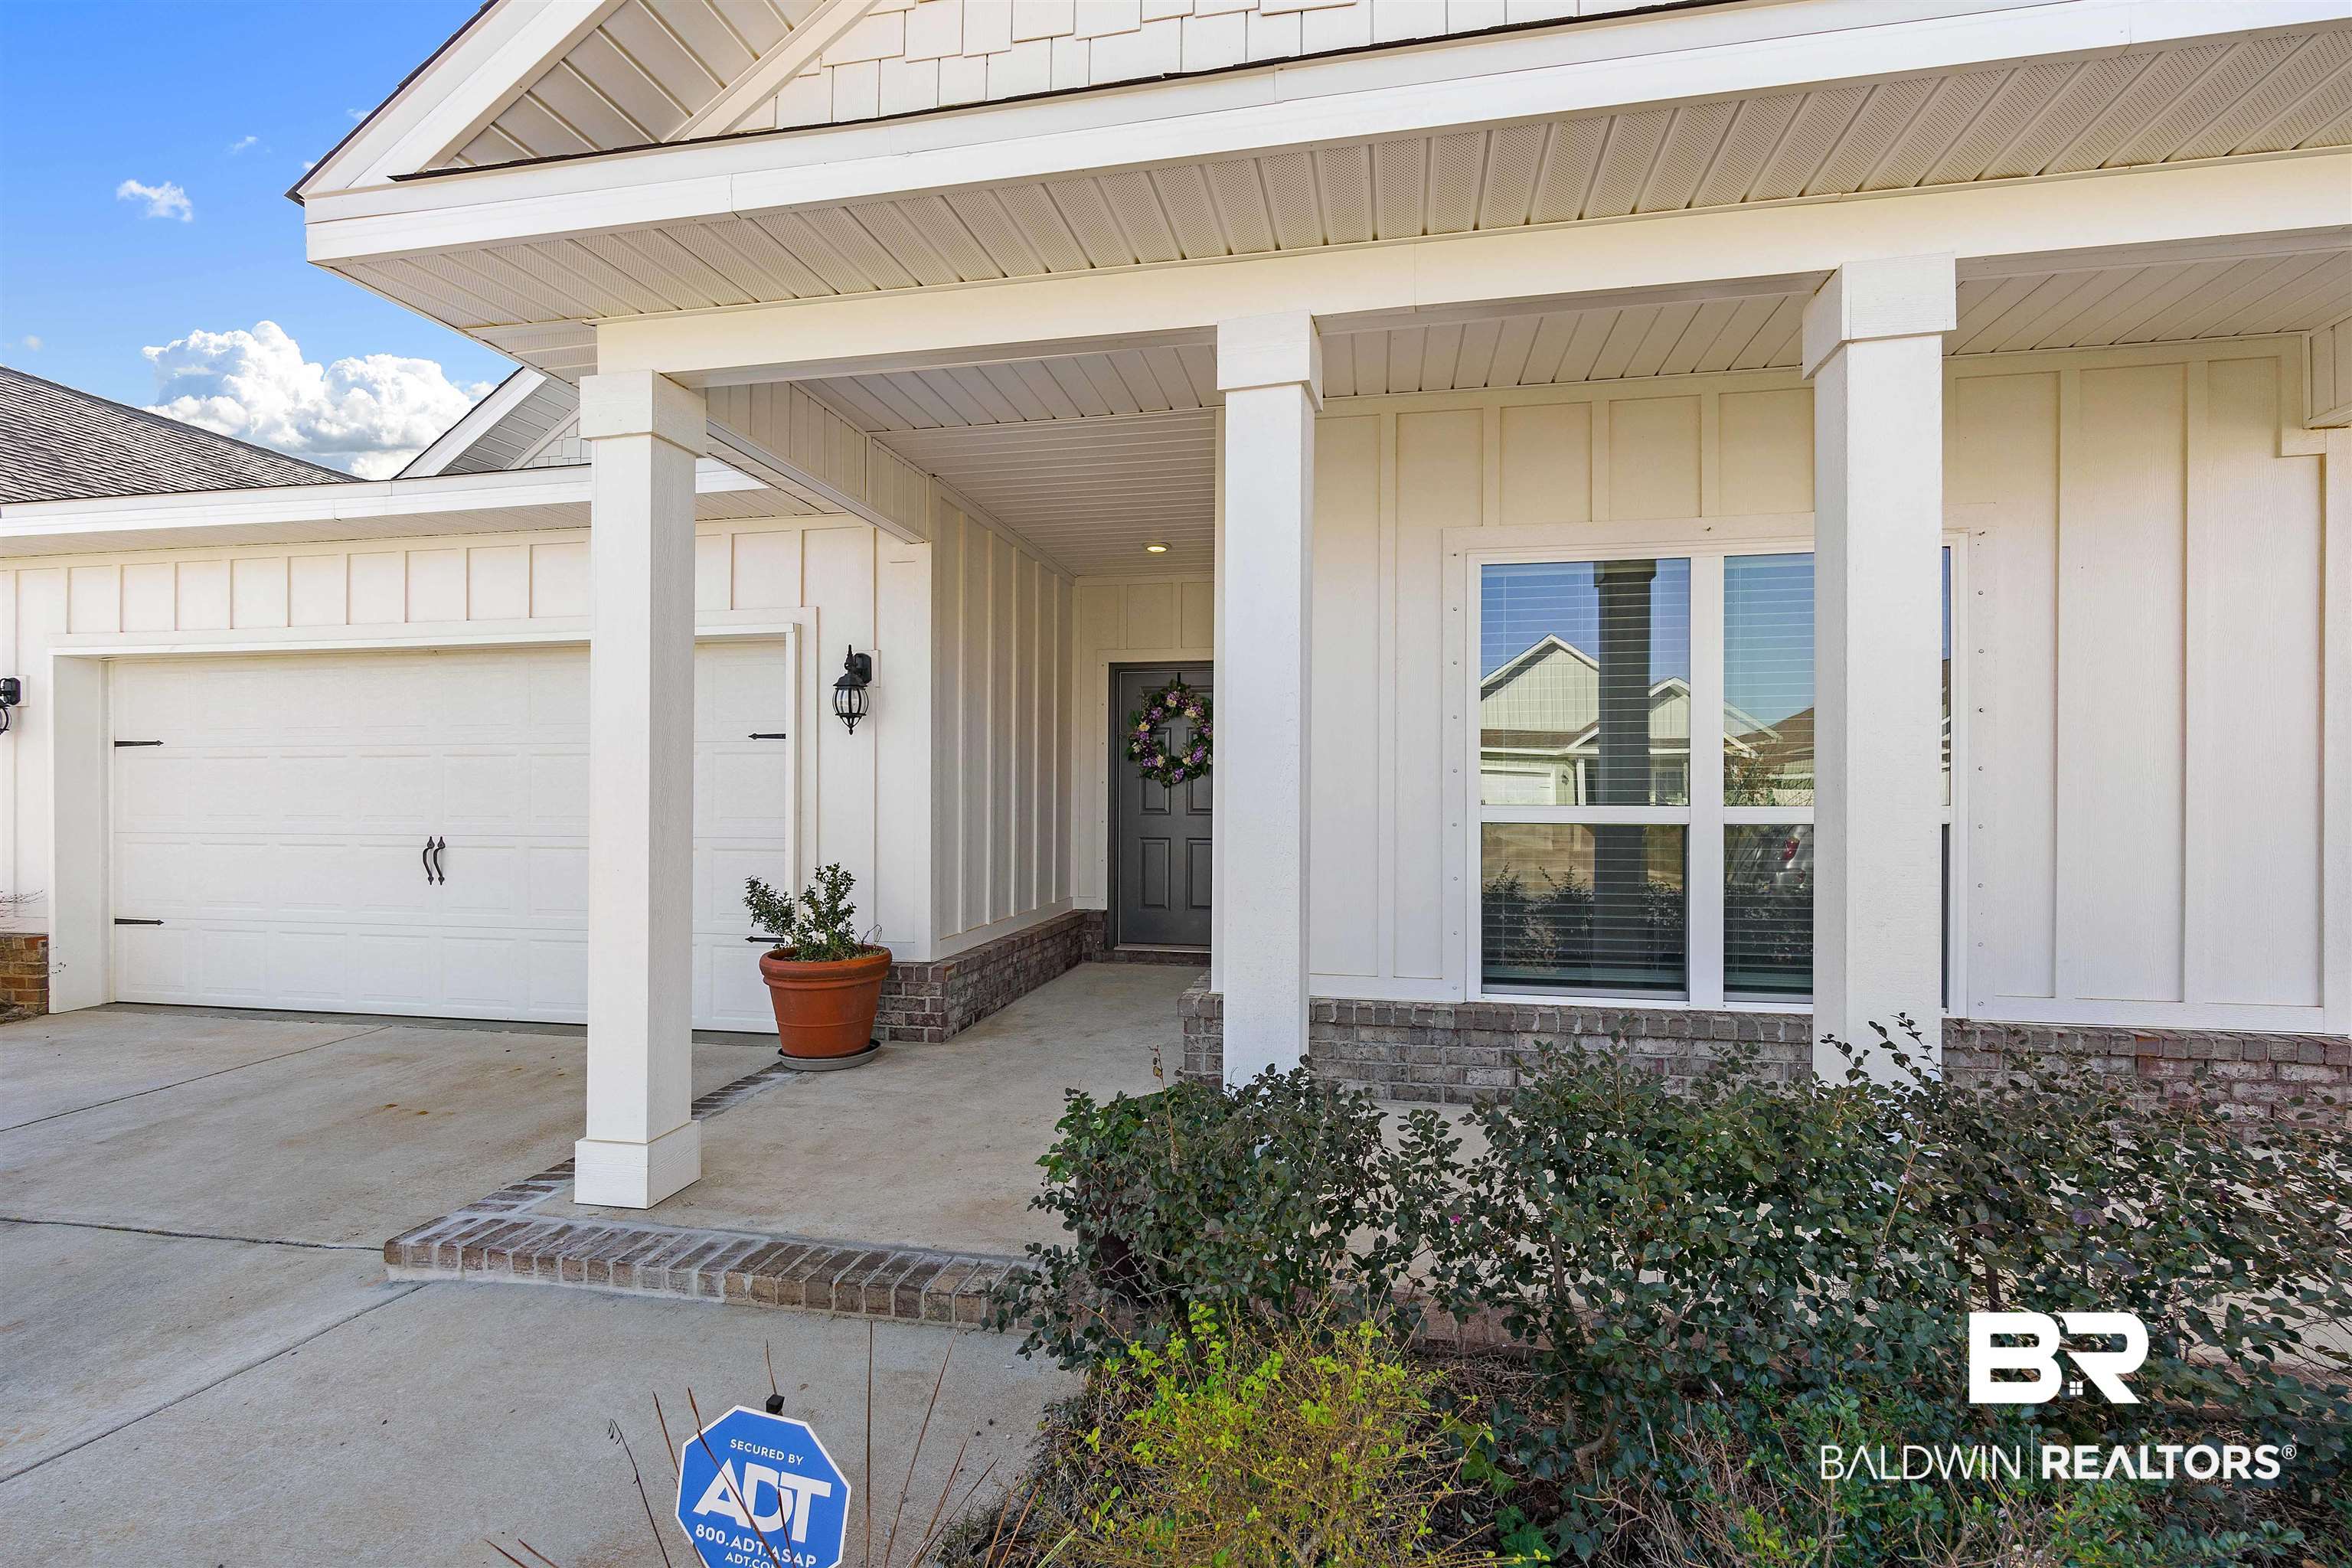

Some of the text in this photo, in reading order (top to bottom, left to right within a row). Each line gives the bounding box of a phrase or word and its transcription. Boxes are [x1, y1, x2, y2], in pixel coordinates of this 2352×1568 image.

[730, 1439, 805, 1465] SECURED BY
[692, 1457, 832, 1544] ADT
[695, 1524, 817, 1568] 800.ADT.ASAP
